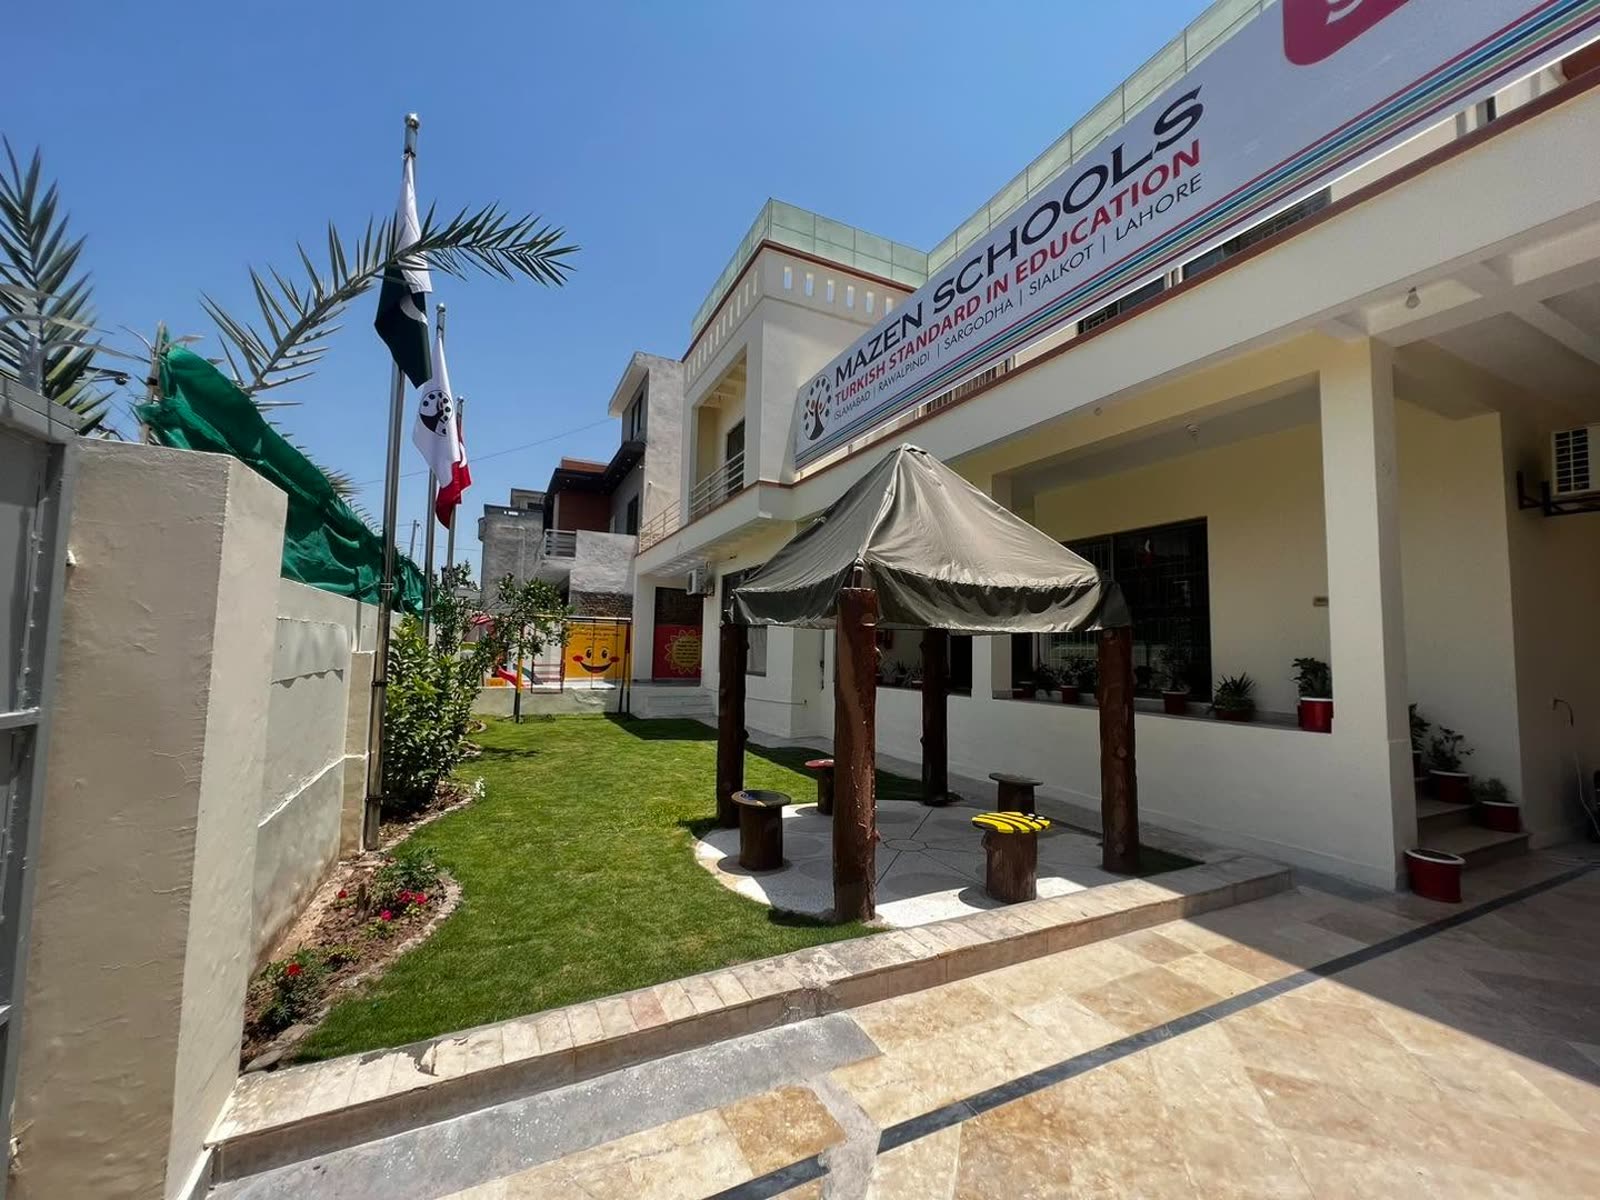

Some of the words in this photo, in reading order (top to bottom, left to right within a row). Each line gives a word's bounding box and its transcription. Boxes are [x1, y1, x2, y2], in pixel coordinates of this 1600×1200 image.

[834, 360, 886, 406] TURKISH
[889, 295, 981, 369] STANDARD
[986, 273, 1009, 304] IN
[1015, 138, 1200, 285] EDUCATION
[834, 390, 871, 420] ISLAMABAD
[878, 351, 930, 391] RAWALPINDI
[944, 298, 1014, 350] SARGODHA
[1029, 243, 1094, 296] SIALKOT
[1116, 172, 1202, 241] LAHORE
[835, 301, 923, 387] MAZEN
[933, 84, 1204, 314] SCHOOLS
